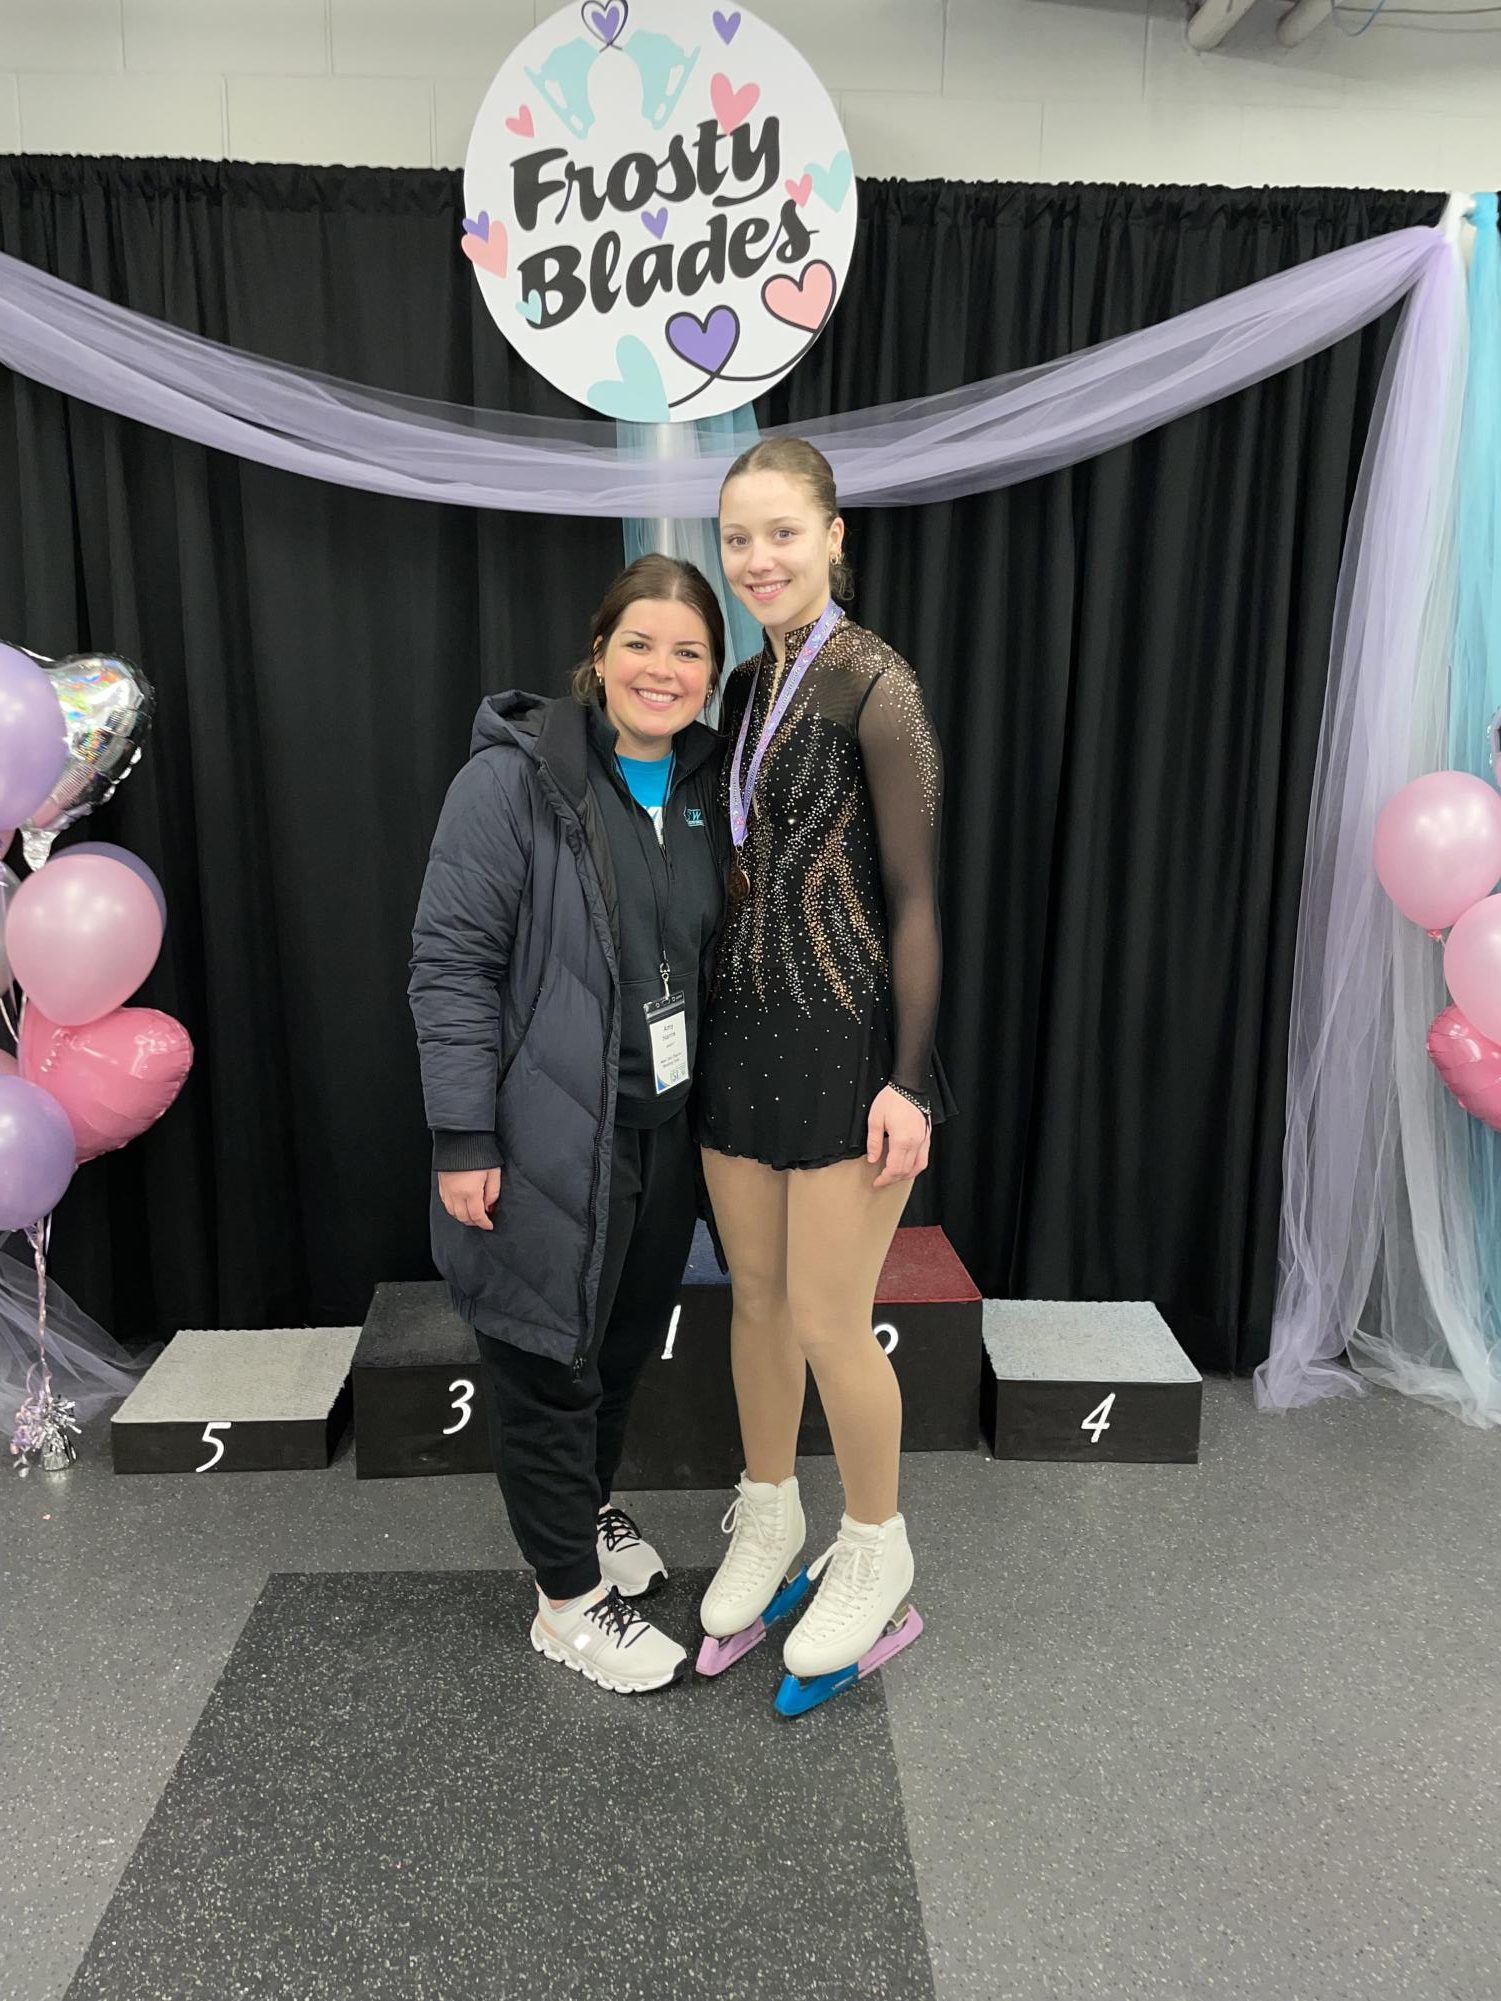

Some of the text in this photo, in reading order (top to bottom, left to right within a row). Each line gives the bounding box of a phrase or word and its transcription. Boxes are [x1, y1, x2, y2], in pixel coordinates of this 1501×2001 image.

[510, 116, 780, 231] Frosty
[517, 199, 819, 329] Blades
[661, 1305, 681, 1360] 1
[443, 1380, 475, 1435] 3
[1081, 1393, 1116, 1443] 4
[195, 1422, 232, 1473] 5
